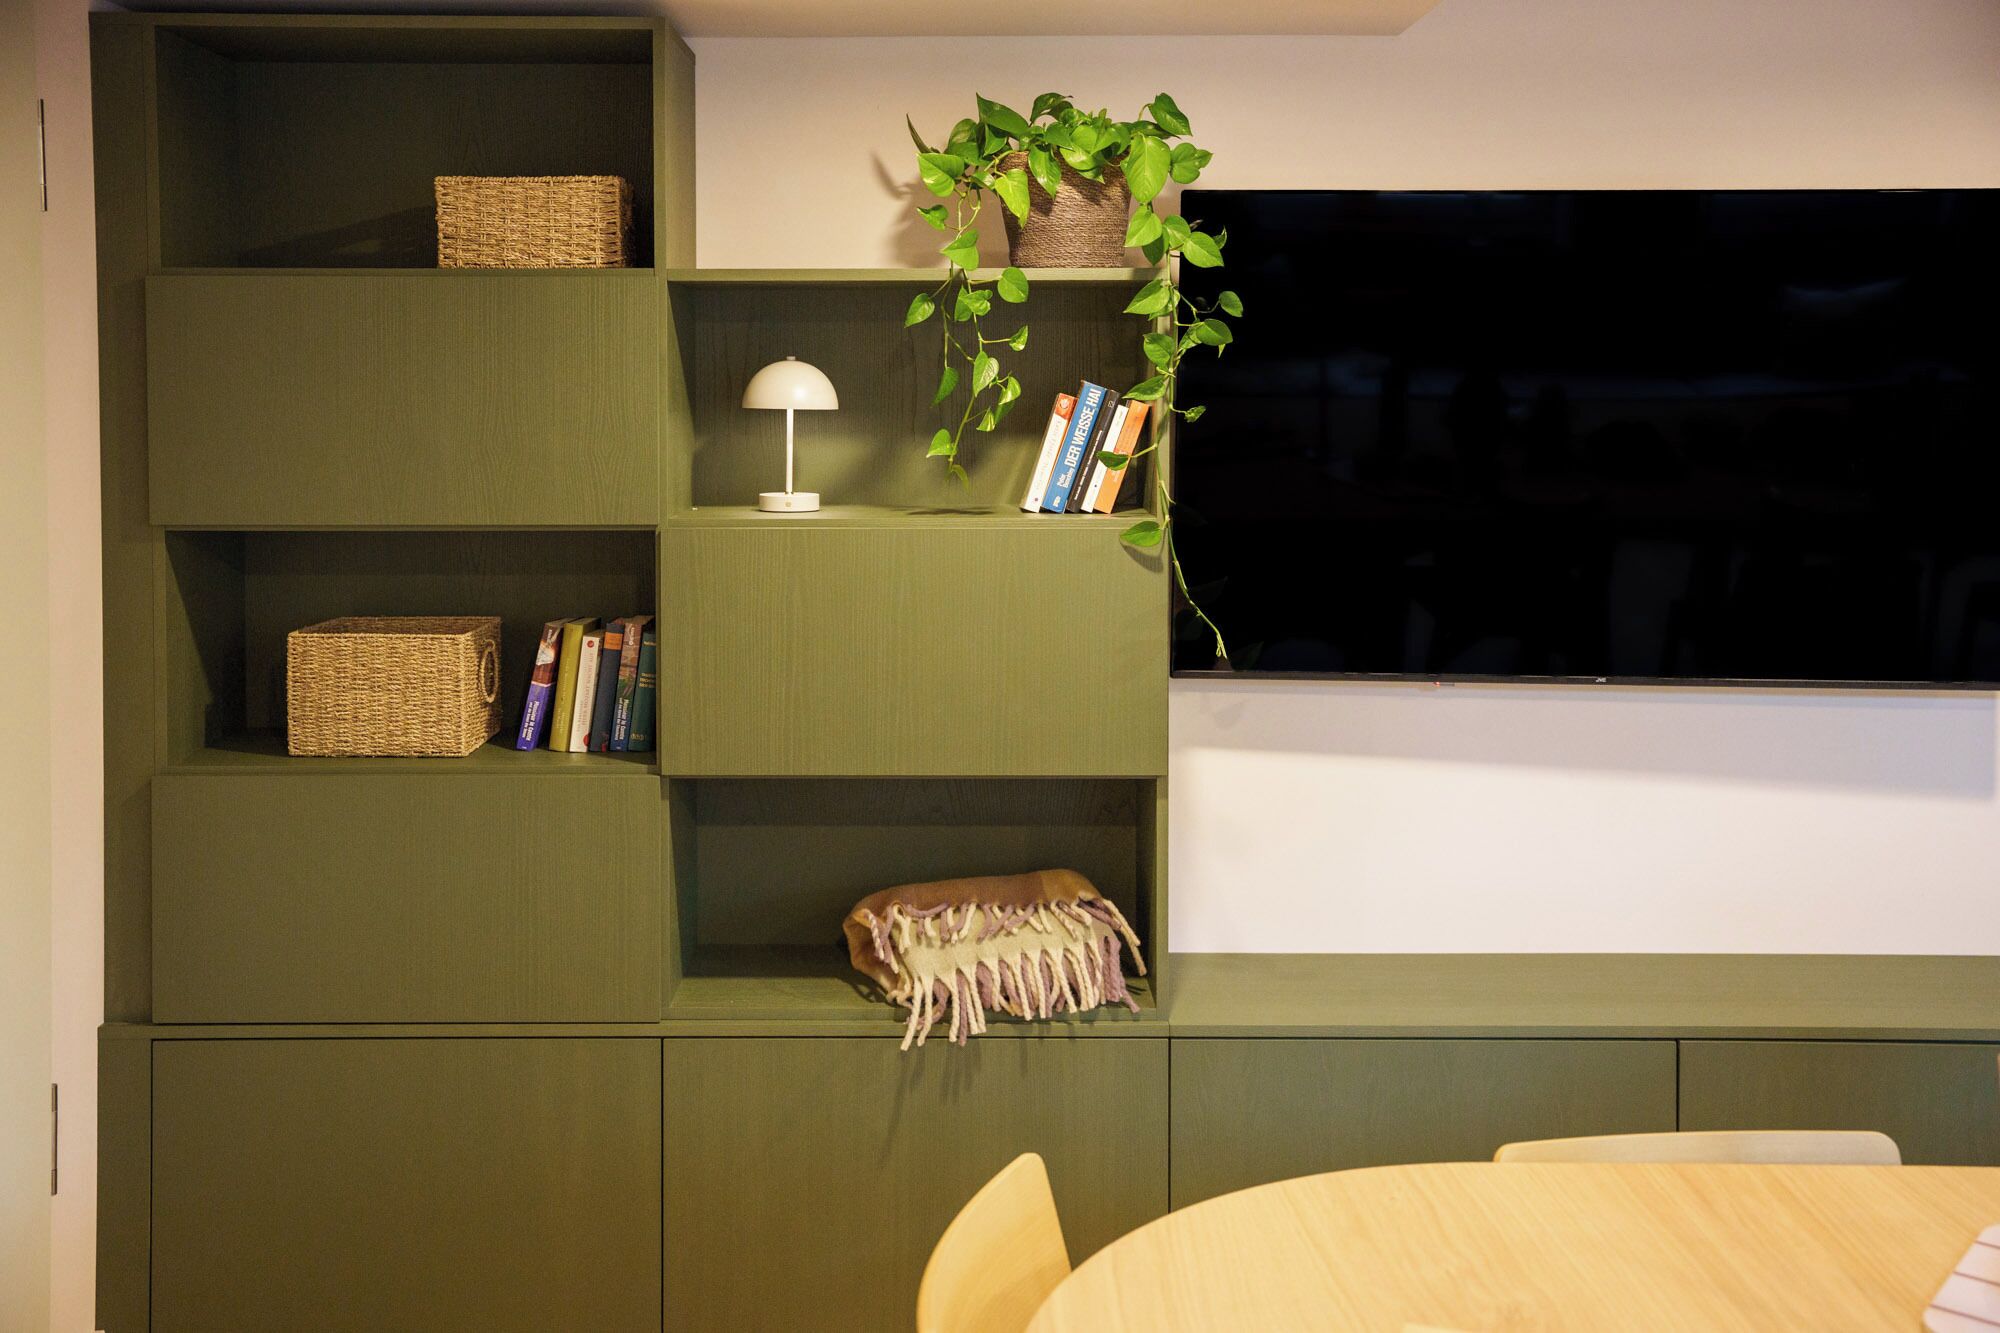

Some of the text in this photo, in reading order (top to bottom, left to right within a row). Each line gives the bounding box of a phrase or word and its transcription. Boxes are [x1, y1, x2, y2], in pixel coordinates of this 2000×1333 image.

[1086, 388, 1102, 410] HAI
[1072, 407, 1094, 445] WEISSE
[1064, 446, 1082, 468] DER
